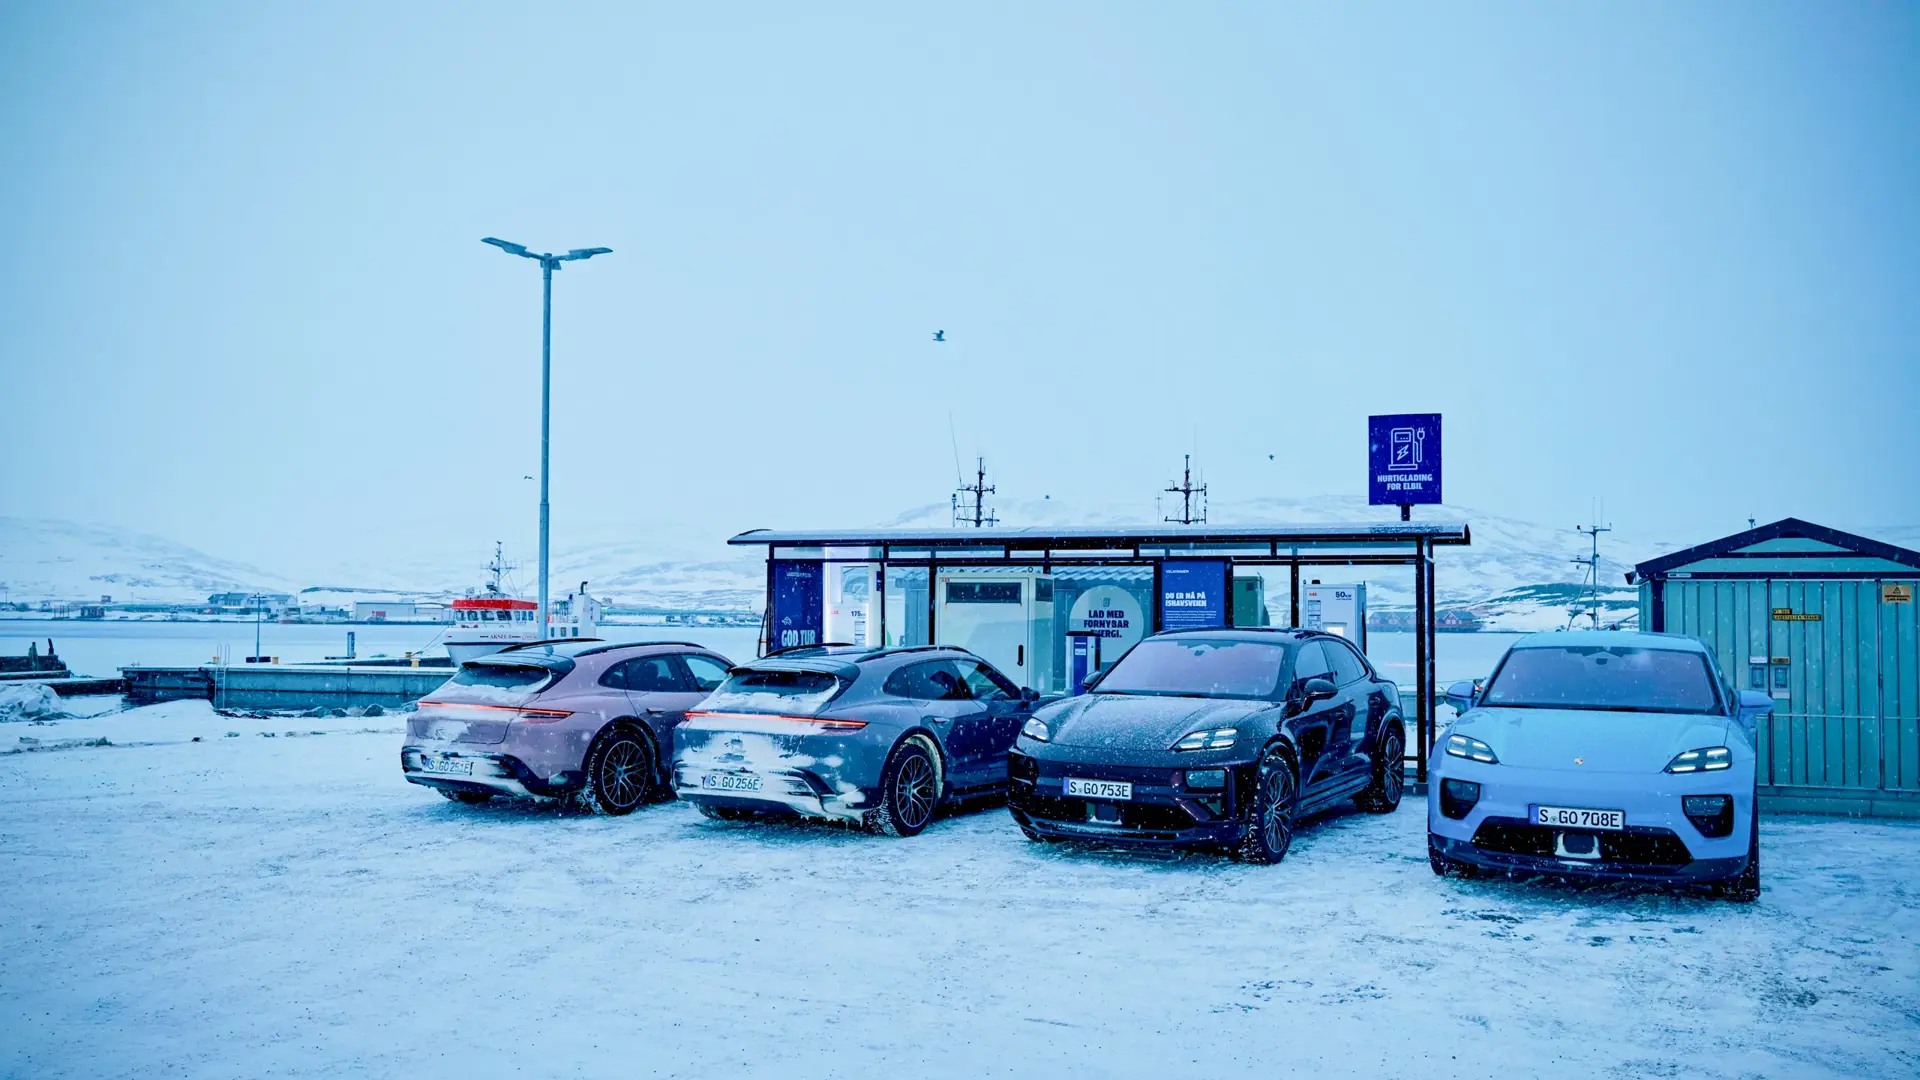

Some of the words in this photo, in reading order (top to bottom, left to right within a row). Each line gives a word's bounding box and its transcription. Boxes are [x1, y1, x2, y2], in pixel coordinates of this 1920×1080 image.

[1377, 474, 1432, 482] HURTIGLADING
[1403, 482, 1423, 490] ELBIL
[1165, 592, 1175, 600] DU
[1176, 592, 1185, 600] ER
[1196, 591, 1206, 600] PÅ
[1088, 610, 1105, 619] LAD
[1106, 610, 1125, 619] MED
[1083, 620, 1129, 629] FORNYBAR
[781, 630, 799, 647] GOD
[800, 630, 816, 645] TUR
[429, 760, 435, 770] S
[710, 775, 717, 787] S
[736, 778, 759, 790] 256E
[1069, 781, 1077, 794] S
[1100, 783, 1129, 798] 753E
[1539, 809, 1549, 823] S
[1581, 811, 1620, 828] 708E
